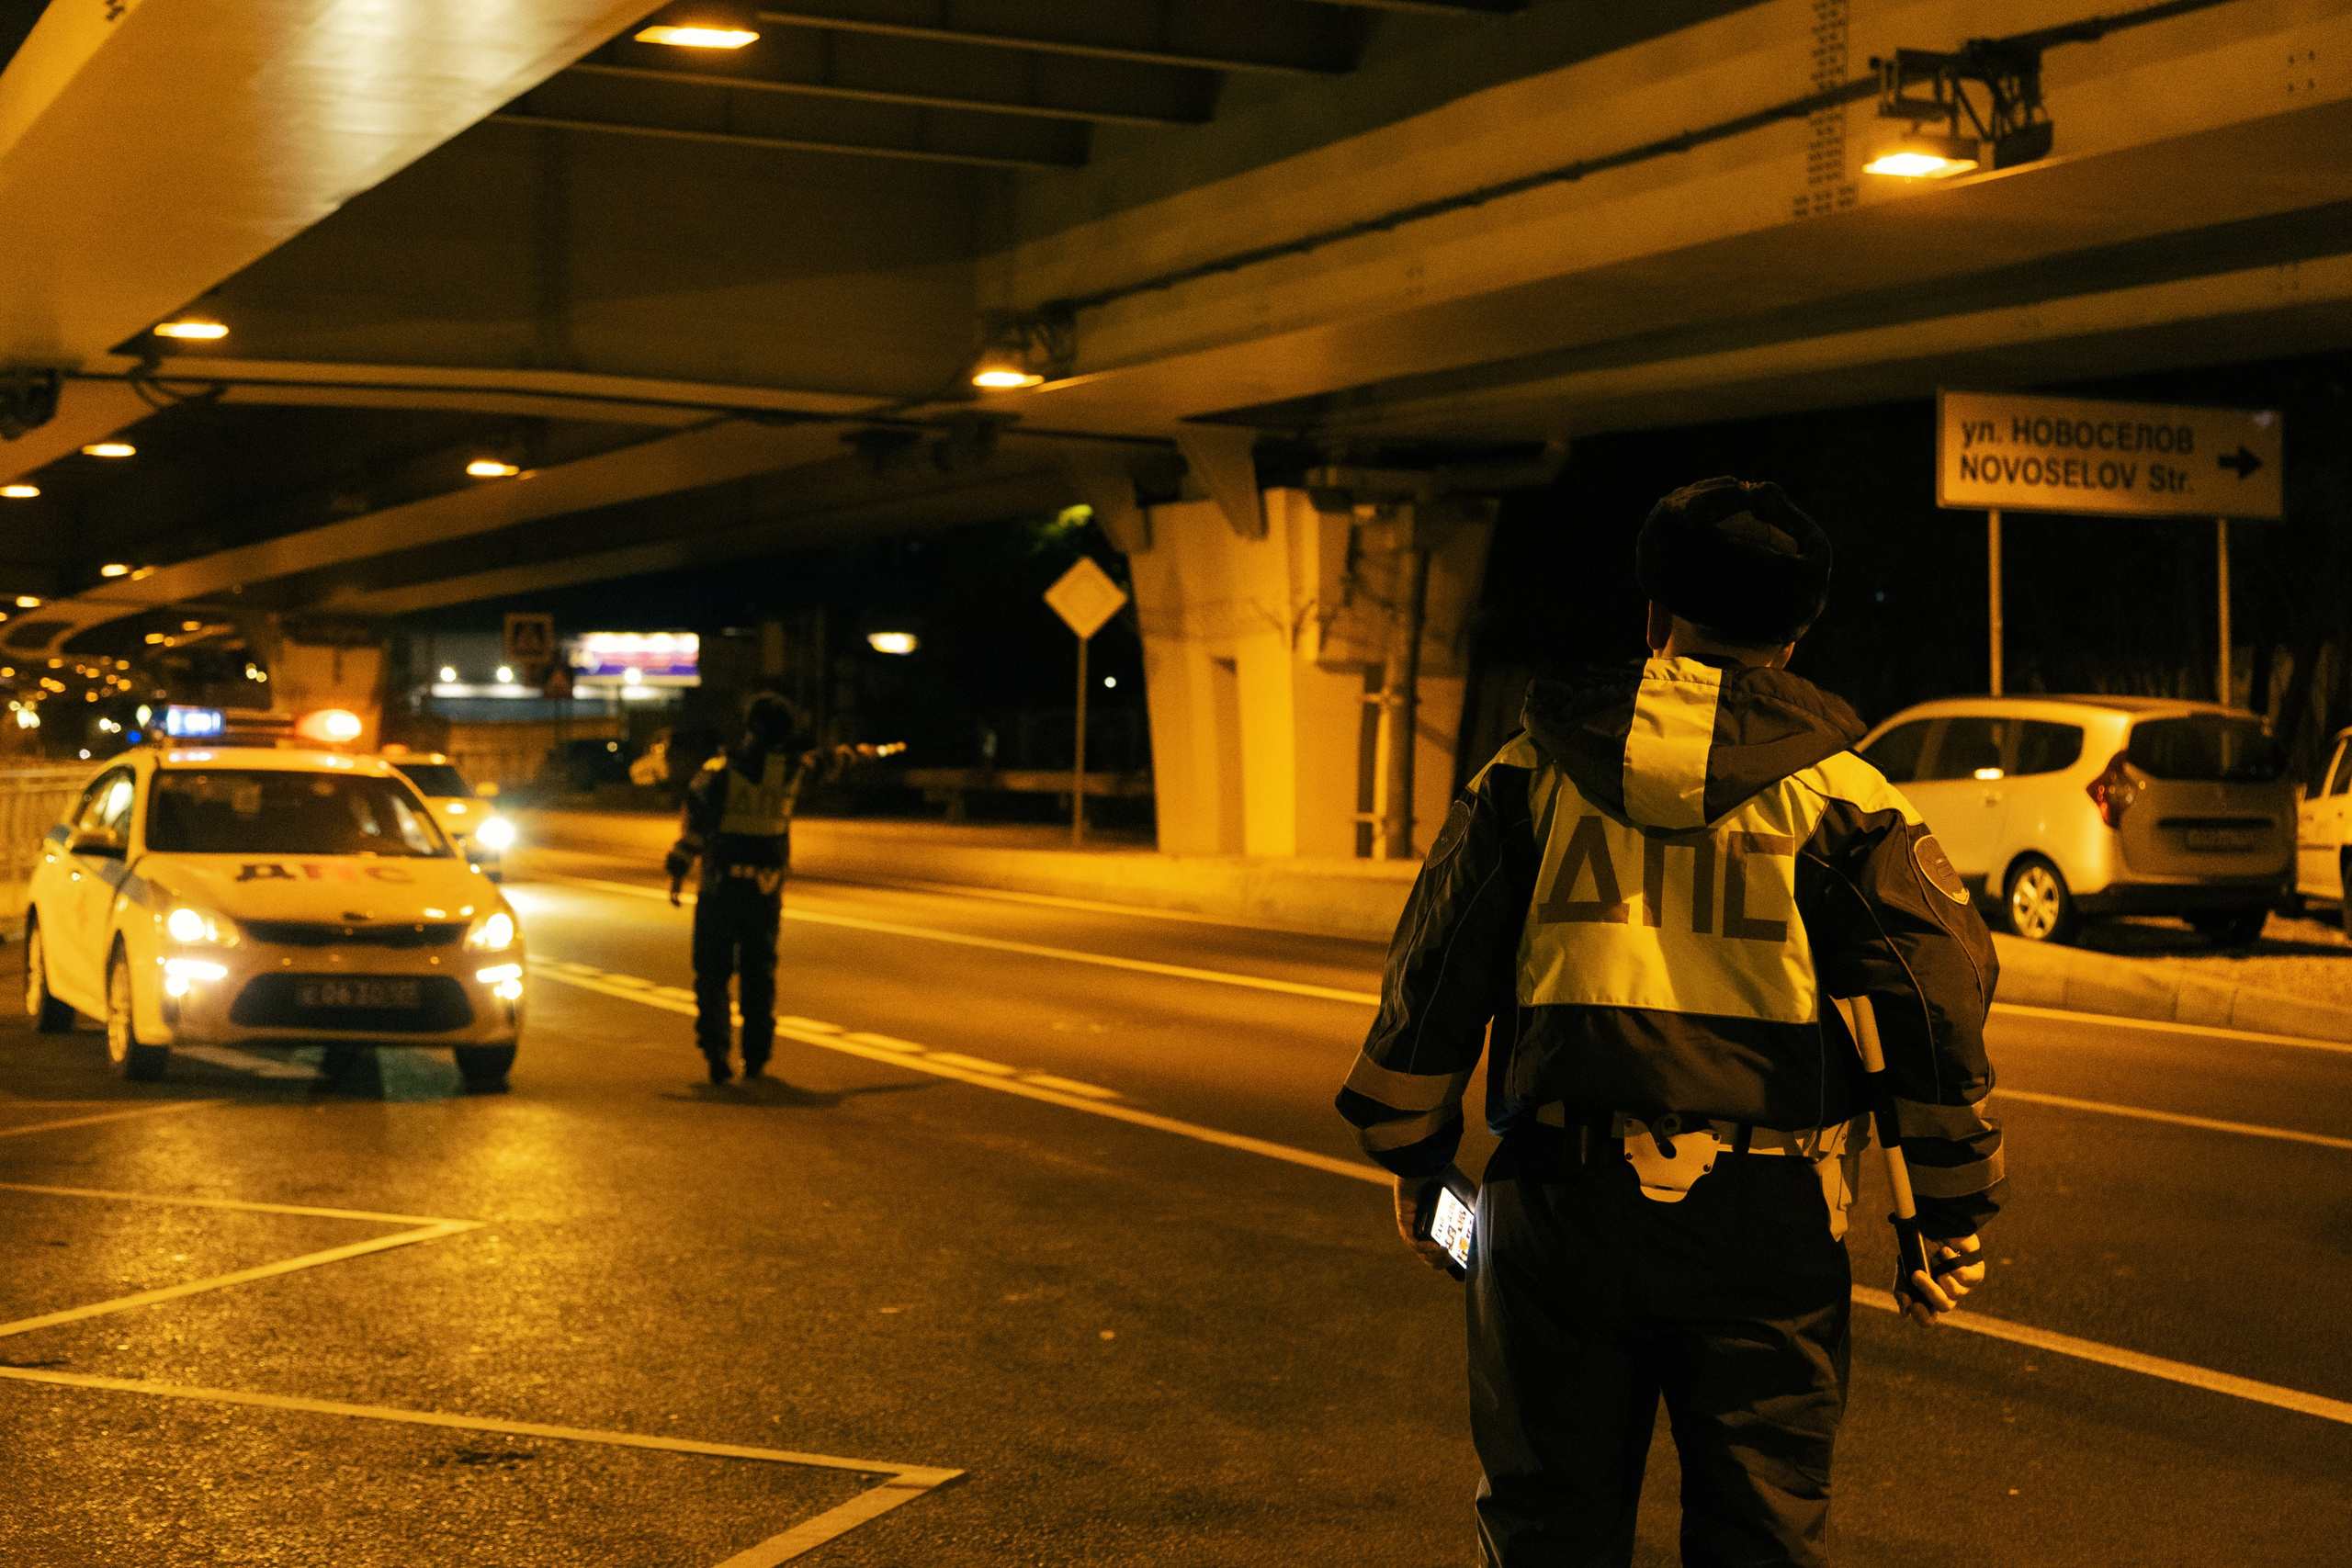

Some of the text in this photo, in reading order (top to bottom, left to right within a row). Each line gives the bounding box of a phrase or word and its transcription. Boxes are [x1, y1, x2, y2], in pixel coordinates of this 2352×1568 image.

[1961, 416, 2195, 455] ул. НОВОСЕЛОВ
[1960, 454, 2195, 493] NOVOSELOV Str.
[1537, 815, 1795, 942] ДПС
